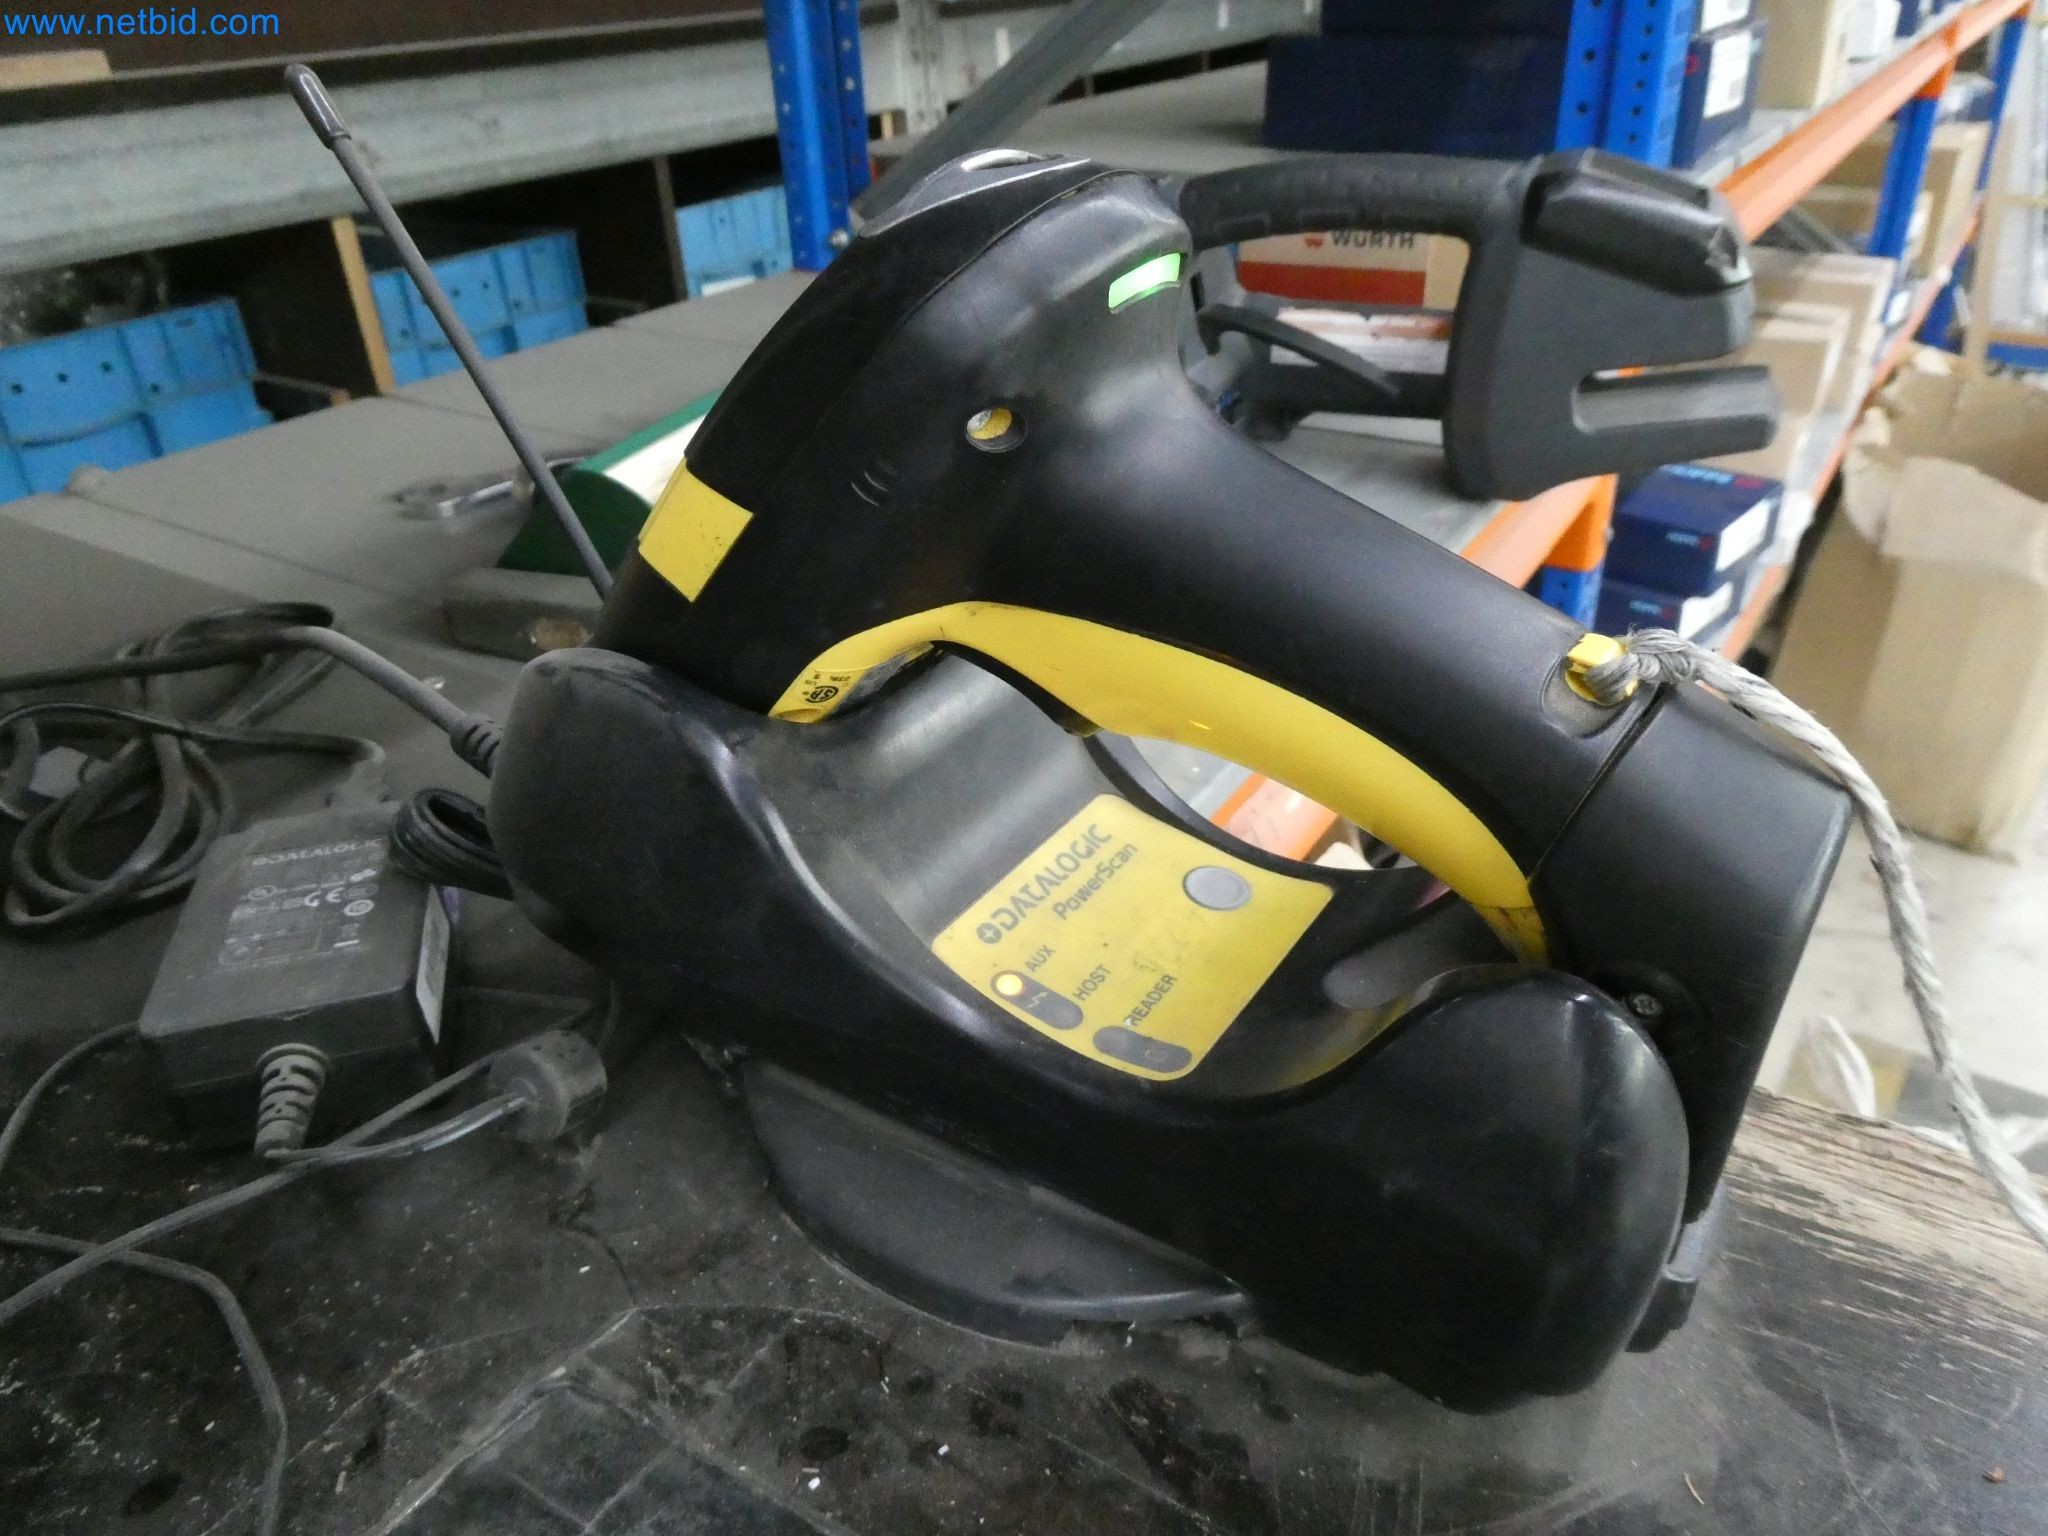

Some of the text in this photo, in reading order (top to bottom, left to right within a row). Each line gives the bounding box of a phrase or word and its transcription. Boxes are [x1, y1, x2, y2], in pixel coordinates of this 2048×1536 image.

[990, 823, 1113, 932] DATALOGIC
[1052, 843, 1138, 920] PowerScan
[1024, 944, 1056, 972] AUX
[1072, 963, 1113, 1001] HOST
[1123, 974, 1178, 1027] READER
